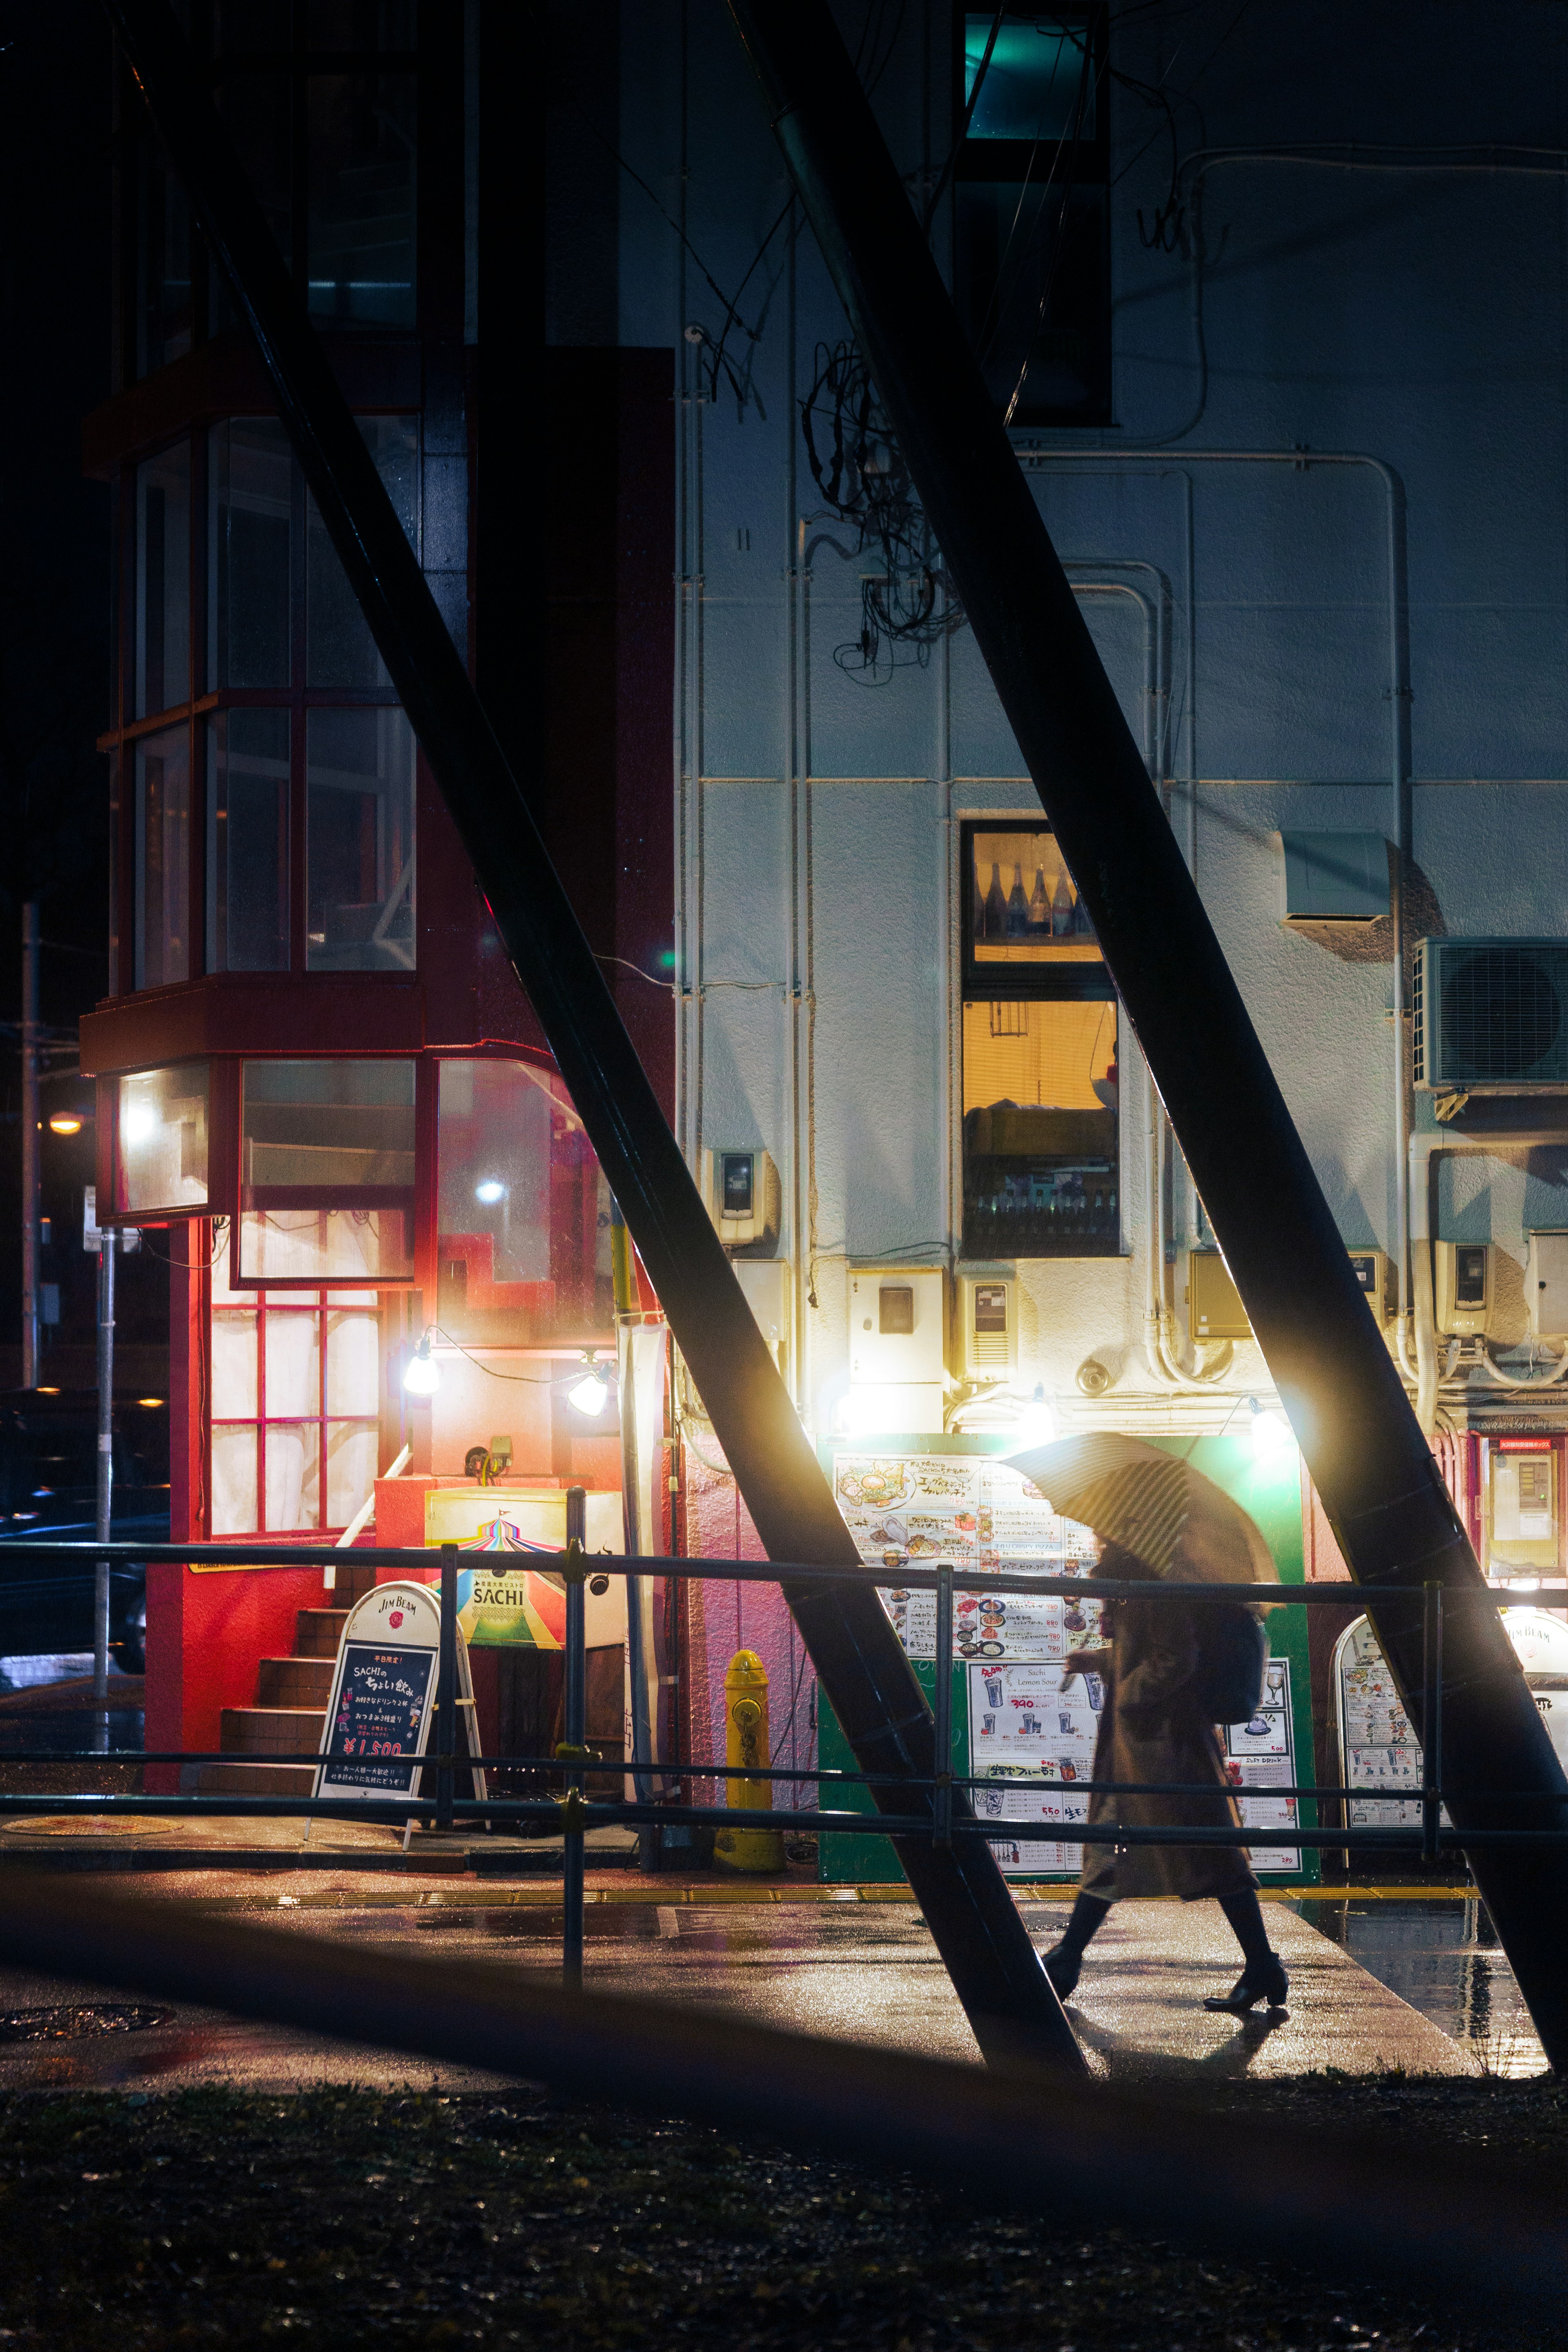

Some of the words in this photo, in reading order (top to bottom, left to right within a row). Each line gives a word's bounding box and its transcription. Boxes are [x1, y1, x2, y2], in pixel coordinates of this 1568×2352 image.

[921, 1486, 966, 1497] カルパッチョ
[474, 1588, 523, 1606] SACHI
[379, 1599, 395, 1613] JIM
[396, 1596, 416, 1616] BEAM
[1525, 1626, 1550, 1643] BEAM
[374, 1655, 403, 1664] 平日限定!
[354, 1667, 387, 1677] SACHIの
[365, 1676, 414, 1697] ちょい飲み
[355, 1696, 409, 1707] お好きなドリンク2杯
[1011, 1699, 1034, 1709] 390
[355, 1713, 402, 1723] おつまみ3種盛り
[1042, 1806, 1060, 1815] 550
